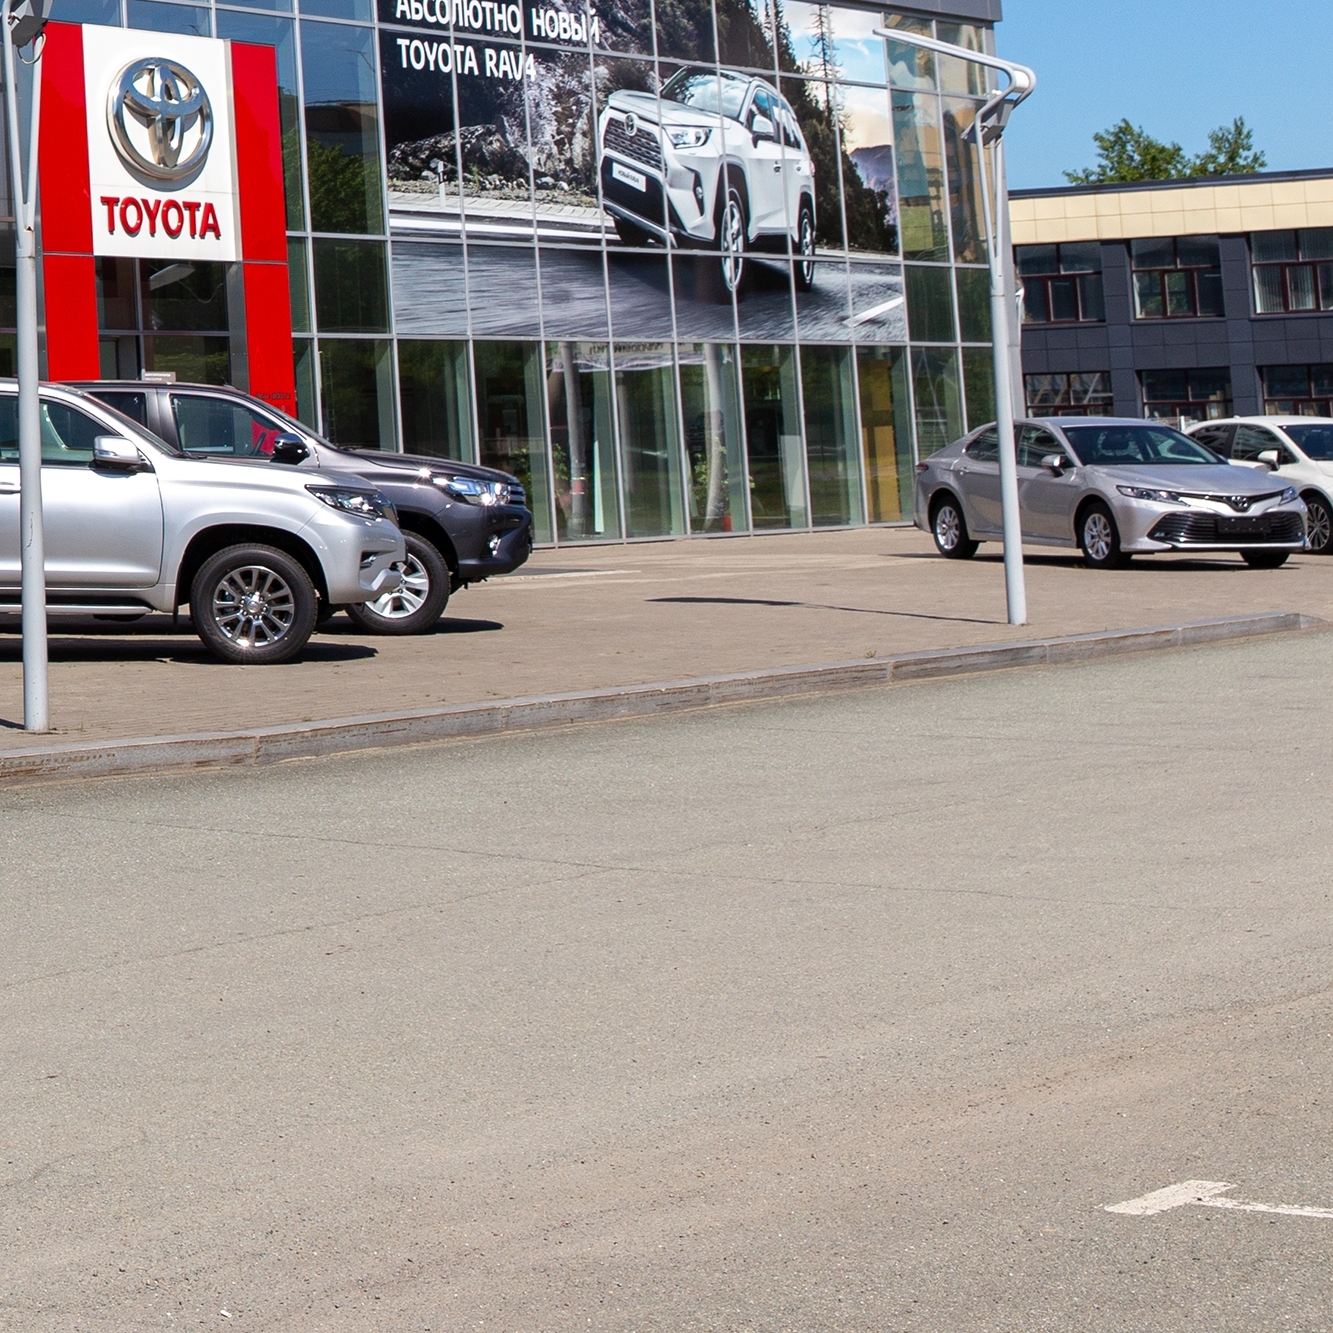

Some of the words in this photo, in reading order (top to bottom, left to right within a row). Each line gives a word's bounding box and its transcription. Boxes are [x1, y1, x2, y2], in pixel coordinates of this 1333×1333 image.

[531, 7, 600, 43] НОВЫЙ
[396, 38, 480, 76] TOYOTA
[485, 47, 536, 82] RAV4
[100, 196, 221, 239] TOYOTA
